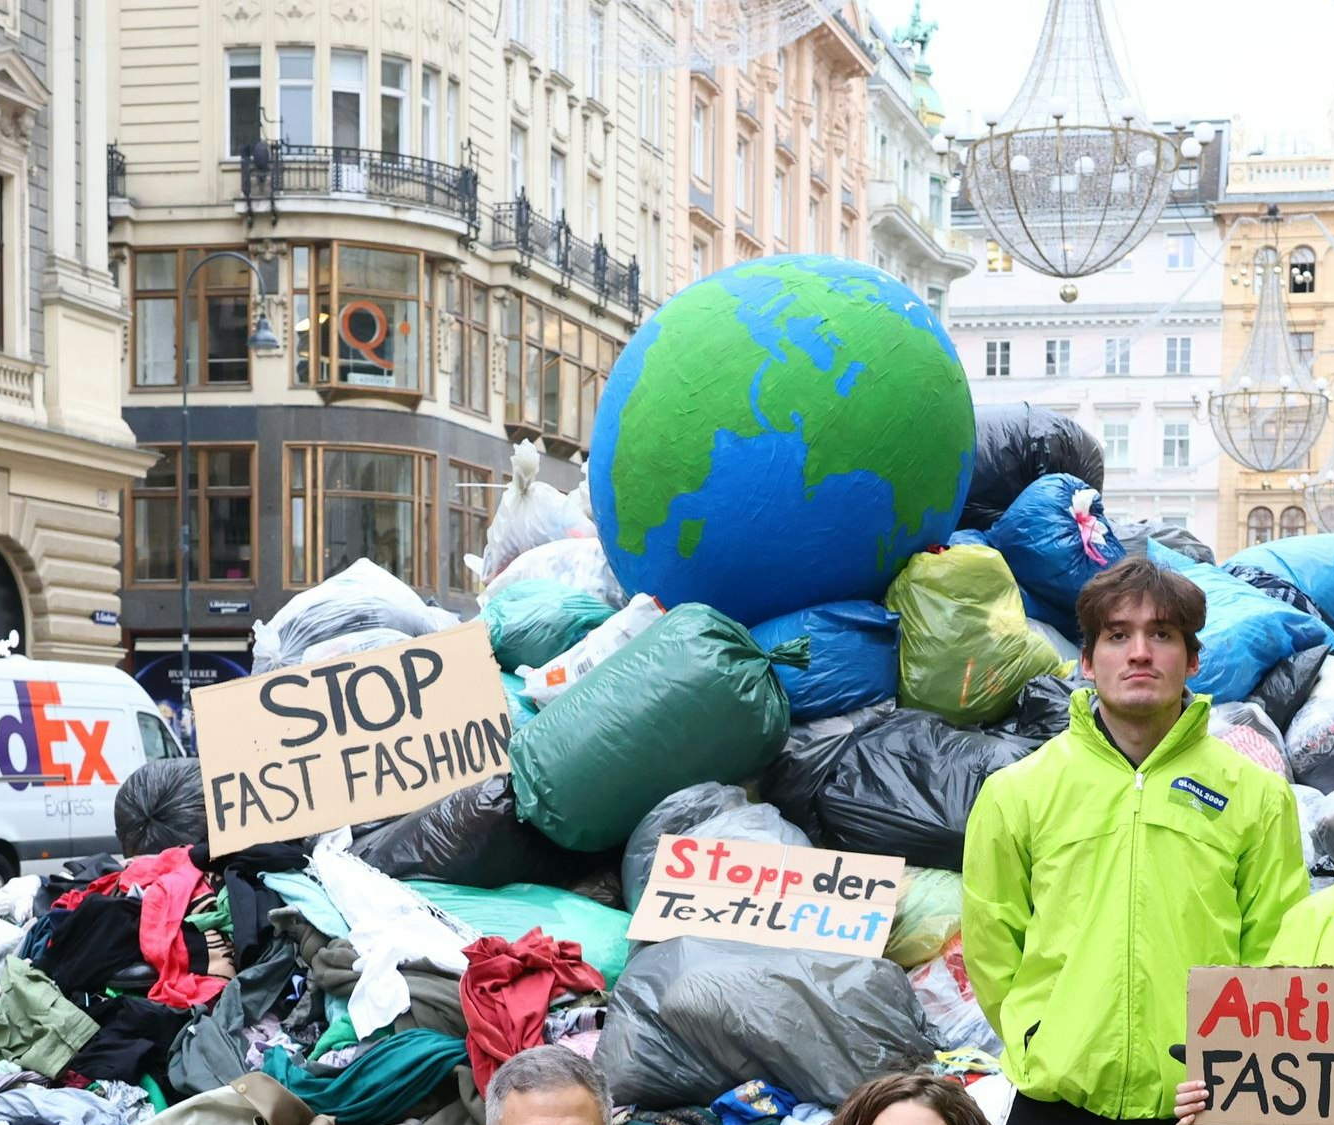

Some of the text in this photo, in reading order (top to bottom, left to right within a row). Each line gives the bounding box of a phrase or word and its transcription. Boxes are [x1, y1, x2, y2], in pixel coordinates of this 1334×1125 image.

[260, 648, 443, 747] STOP
[211, 713, 512, 831] FAST FASHION
[1178, 778, 1225, 807] GLOBAL 2000
[44, 794, 95, 821] Express
[665, 838, 803, 898] Stopp
[812, 856, 896, 900] der
[655, 890, 888, 941] Textilflut
[1197, 975, 1330, 1044] Anti
